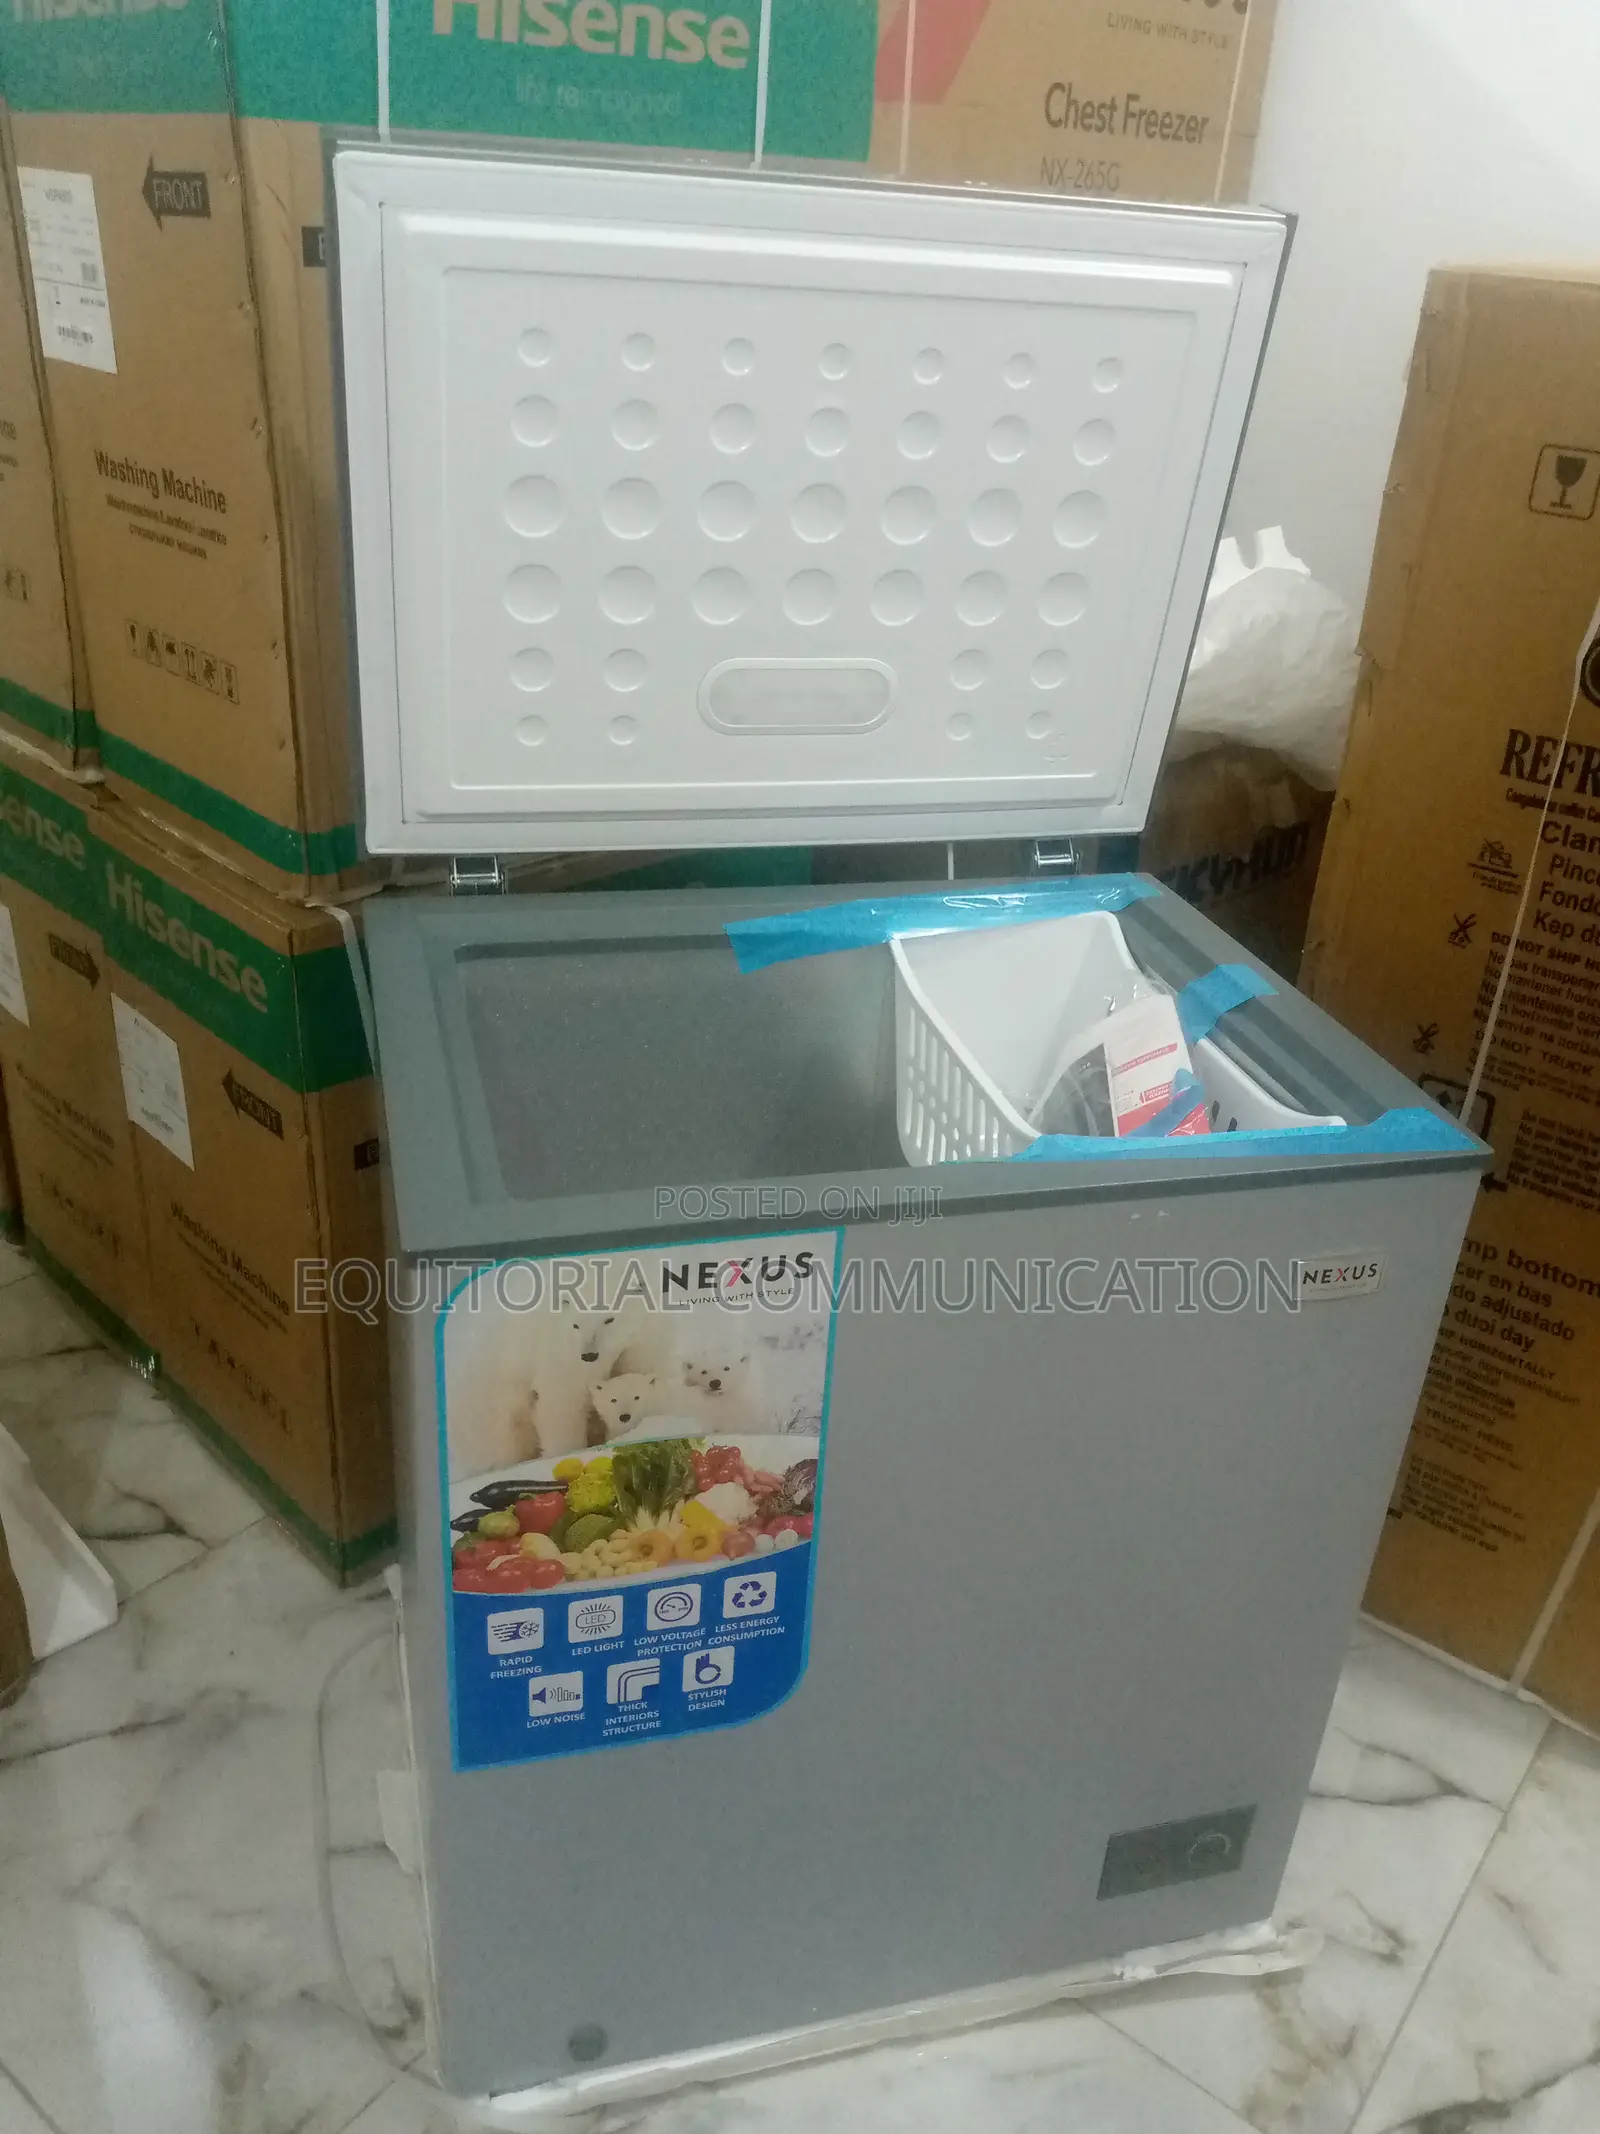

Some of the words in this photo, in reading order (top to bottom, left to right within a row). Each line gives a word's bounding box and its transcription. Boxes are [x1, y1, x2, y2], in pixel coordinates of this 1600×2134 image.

[1107, 12, 1151, 35] LIVING
[1157, 21, 1187, 41] WITH
[1044, 81, 1117, 135] Chest
[1122, 93, 1210, 145] Freezer
[151, 178, 204, 211] FRONT
[93, 448, 160, 500] Washing
[162, 467, 227, 515] Machine
[105, 859, 269, 1014] Hisense
[662, 1252, 814, 1293] NEXUS
[1302, 1262, 1379, 1285] NEXUS
[1507, 1248, 1600, 1301] bottom
[679, 1295, 721, 1306] LIVING
[724, 1291, 754, 1303] WITH
[757, 1286, 795, 1299] STYLE
[1489, 1274, 1512, 1294] en
[1517, 1280, 1552, 1309] bas
[585, 1613, 606, 1625] LED
[715, 1622, 738, 1633] LESS
[740, 1615, 780, 1629] ENERGY
[634, 1636, 658, 1646] LOW
[661, 1627, 706, 1642] VOLTAGE
[708, 1626, 785, 1645] CONSUMPTION
[572, 1647, 591, 1656] LED
[594, 1640, 625, 1652] LIGHT
[637, 1639, 702, 1657] PROTECTION
[500, 1655, 533, 1667] RAPID
[490, 1666, 542, 1679] FREEZING
[688, 1688, 727, 1701] STYLISH
[618, 1702, 648, 1713] THICK
[688, 1699, 725, 1711] DESIGN
[526, 1717, 550, 1729] LOW
[554, 1712, 585, 1724] NOISE
[605, 1710, 660, 1726] INTERIORS
[602, 1721, 662, 1737] STRUCTURE
